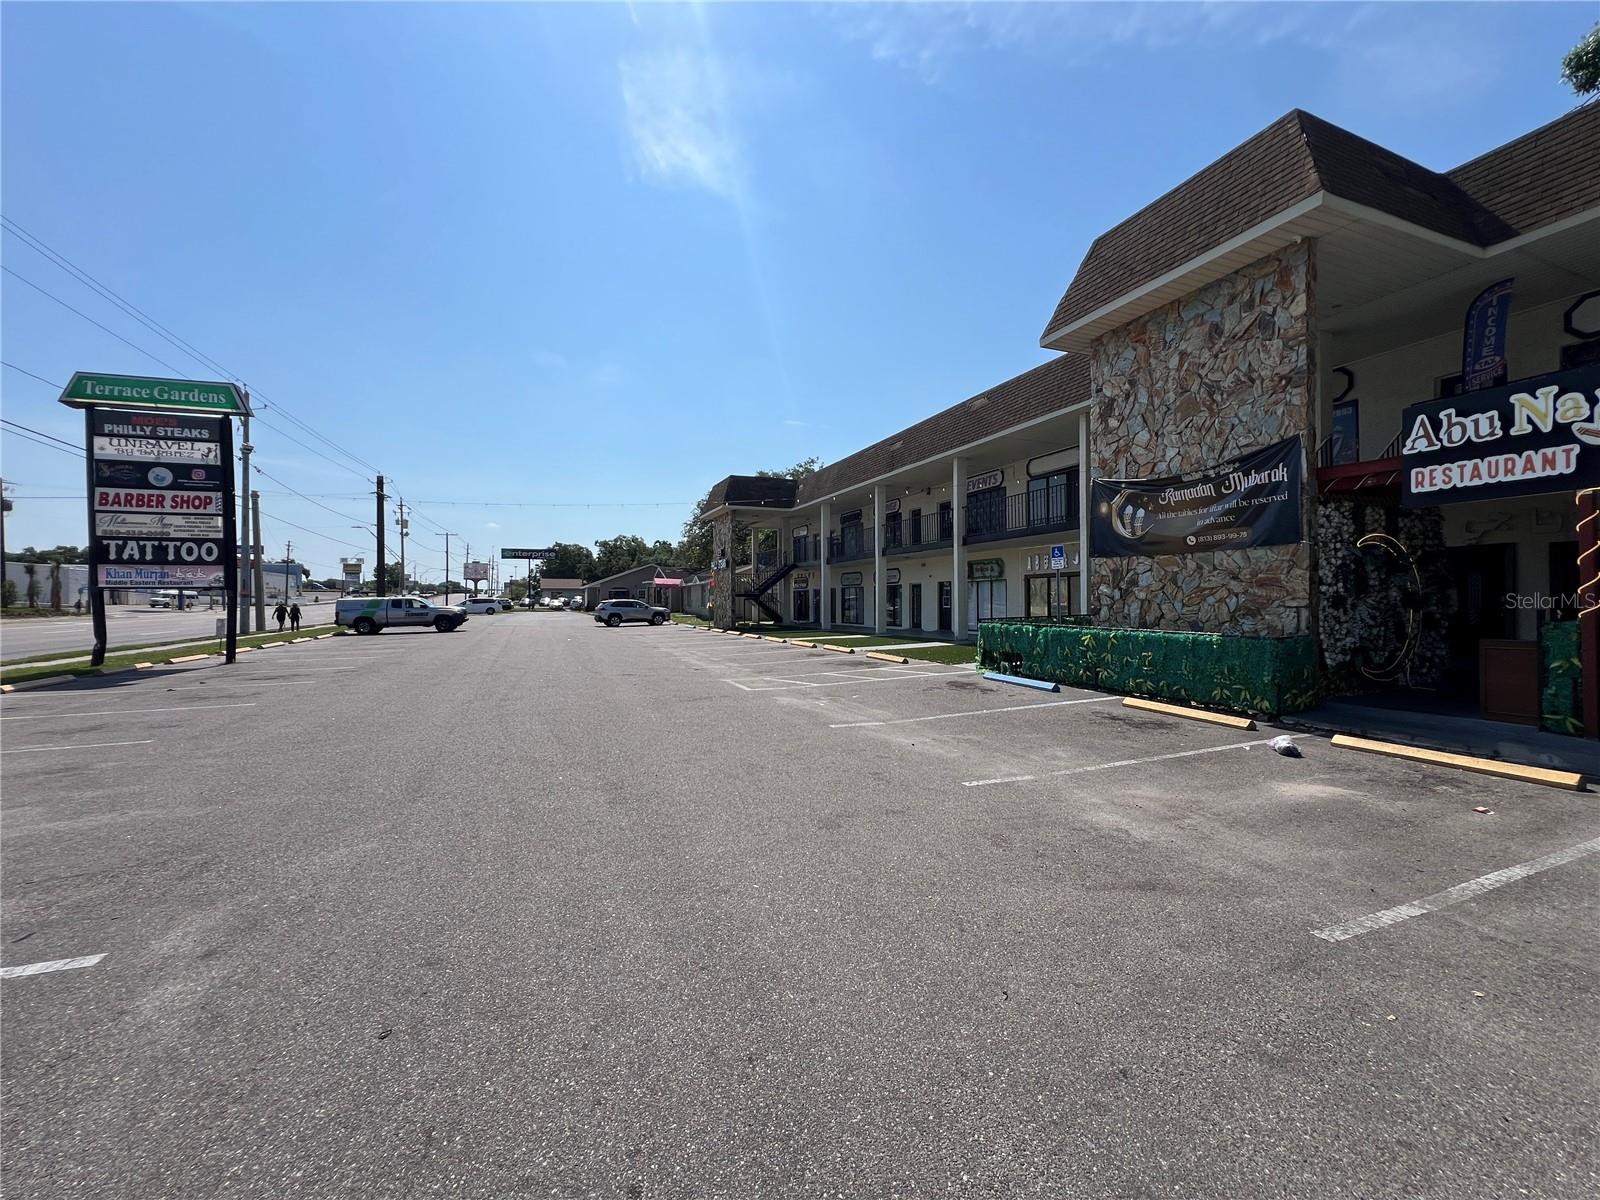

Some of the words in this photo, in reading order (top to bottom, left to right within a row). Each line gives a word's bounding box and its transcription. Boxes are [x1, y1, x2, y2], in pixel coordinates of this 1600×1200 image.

[82, 380, 150, 399] Terrace
[153, 385, 226, 404] Gardens
[1402, 407, 1503, 455] Abu
[1509, 385, 1600, 436] Na
[103, 423, 153, 437] PHILLY
[156, 427, 210, 439] STEAKS
[108, 438, 201, 452] UNRAVEL
[1411, 444, 1580, 493] RESTAURANT
[967, 473, 998, 491] EVENTS
[1158, 483, 1215, 506] Ramadan
[1221, 462, 1288, 495] Mubarak
[98, 491, 166, 509] BARBER
[170, 494, 213, 510] SHOP
[1167, 510, 1178, 519] the
[1178, 508, 1197, 518] tables
[1197, 506, 1208, 516] for
[1224, 501, 1238, 511] will
[1239, 497, 1250, 507] be
[1251, 491, 1288, 506] reserved
[1196, 518, 1203, 527] in
[1203, 515, 1236, 525] advance
[101, 540, 218, 561] TATTOO
[105, 567, 132, 579] Khan
